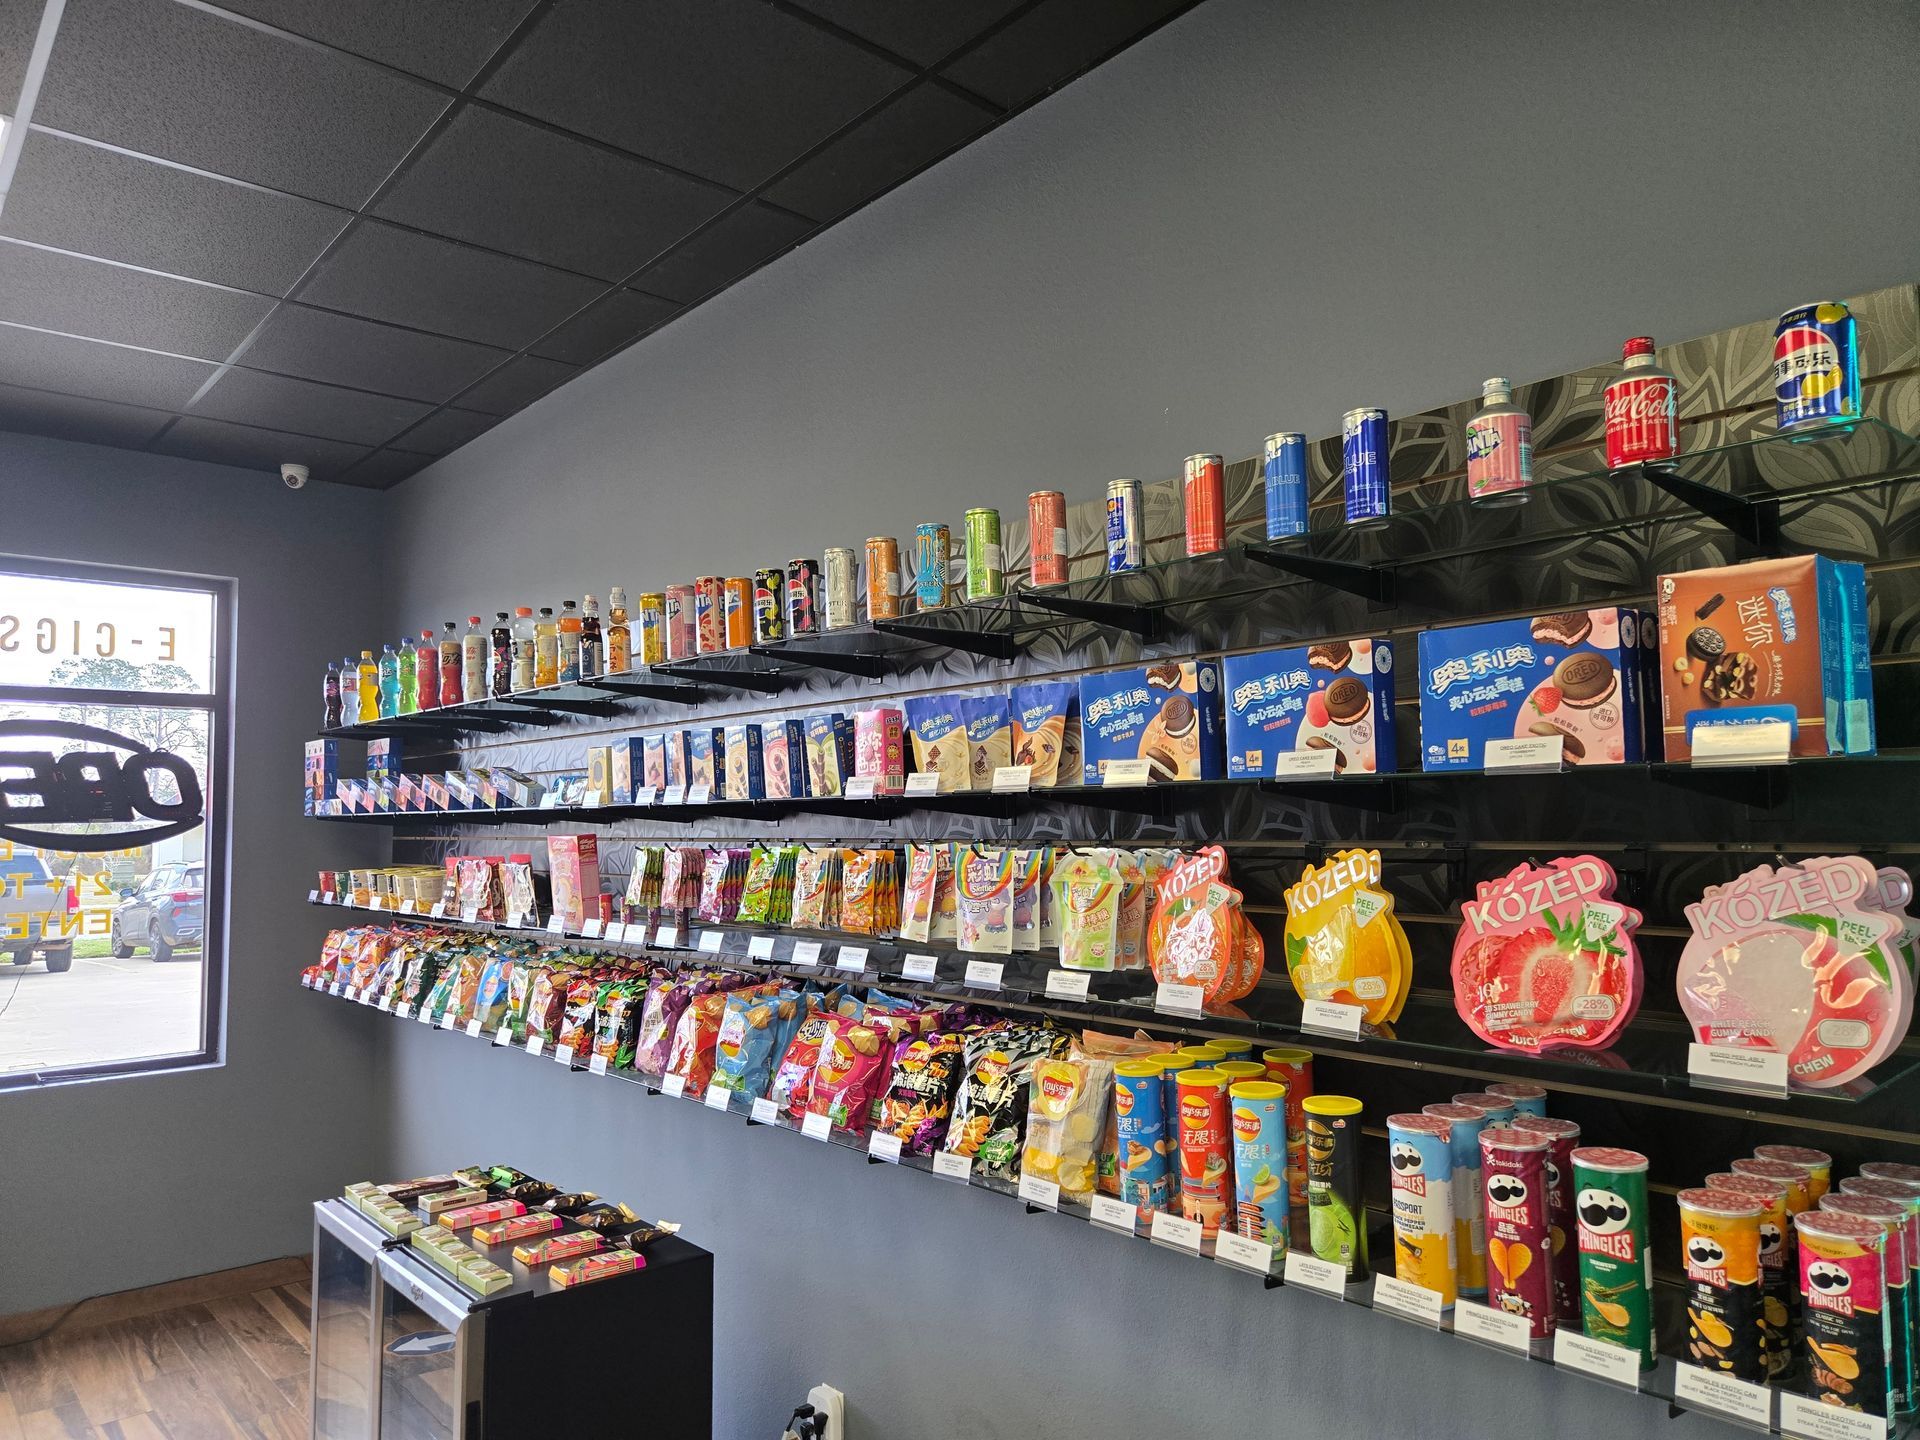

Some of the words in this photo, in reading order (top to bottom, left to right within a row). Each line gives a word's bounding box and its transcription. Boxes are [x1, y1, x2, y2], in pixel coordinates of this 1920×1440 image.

[1607, 419, 1640, 435] ORIGINAL
[1466, 427, 1504, 455] ANTA
[1344, 451, 1377, 470] LUE
[1735, 595, 1774, 649] 迷你
[1431, 645, 1536, 695] 奥利奥
[1565, 663, 1599, 682] OREO
[1233, 670, 1311, 712] 奥利奥
[1332, 685, 1357, 701] OREO
[1449, 675, 1525, 712] 夹心云朵蛋糕
[1087, 689, 1151, 725] 奥利奥
[1167, 702, 1187, 718] OREO
[1246, 696, 1304, 727] 夹心云朵蛋糕
[1157, 850, 1223, 906] KÓZED
[1287, 853, 1368, 918] KÓZED
[1356, 897, 1379, 911] PEEL-
[1467, 860, 1604, 936] KÓZED
[1692, 861, 1862, 941] KÓZED
[1743, 1028, 1776, 1037] CANDY
[1793, 1053, 1835, 1076] CHEW
[1183, 1130, 1210, 1145] 无限
[1488, 1200, 1529, 1225] PRINGLES
[1578, 1223, 1632, 1260] PRINGLES
[1688, 1260, 1726, 1287] PRINGLES
[1807, 1286, 1853, 1315] PRINGLES
[1613, 1355, 1626, 1364] CAN
[1690, 1374, 1720, 1388] PRINGLES
[1743, 1390, 1758, 1400] CAN
[1796, 1405, 1830, 1419] PRINGLES
[1830, 1414, 1856, 1426] EXOTIC
[1856, 1420, 1872, 1431] CAN
[1818, 1418, 1840, 1428] CLASSIC
